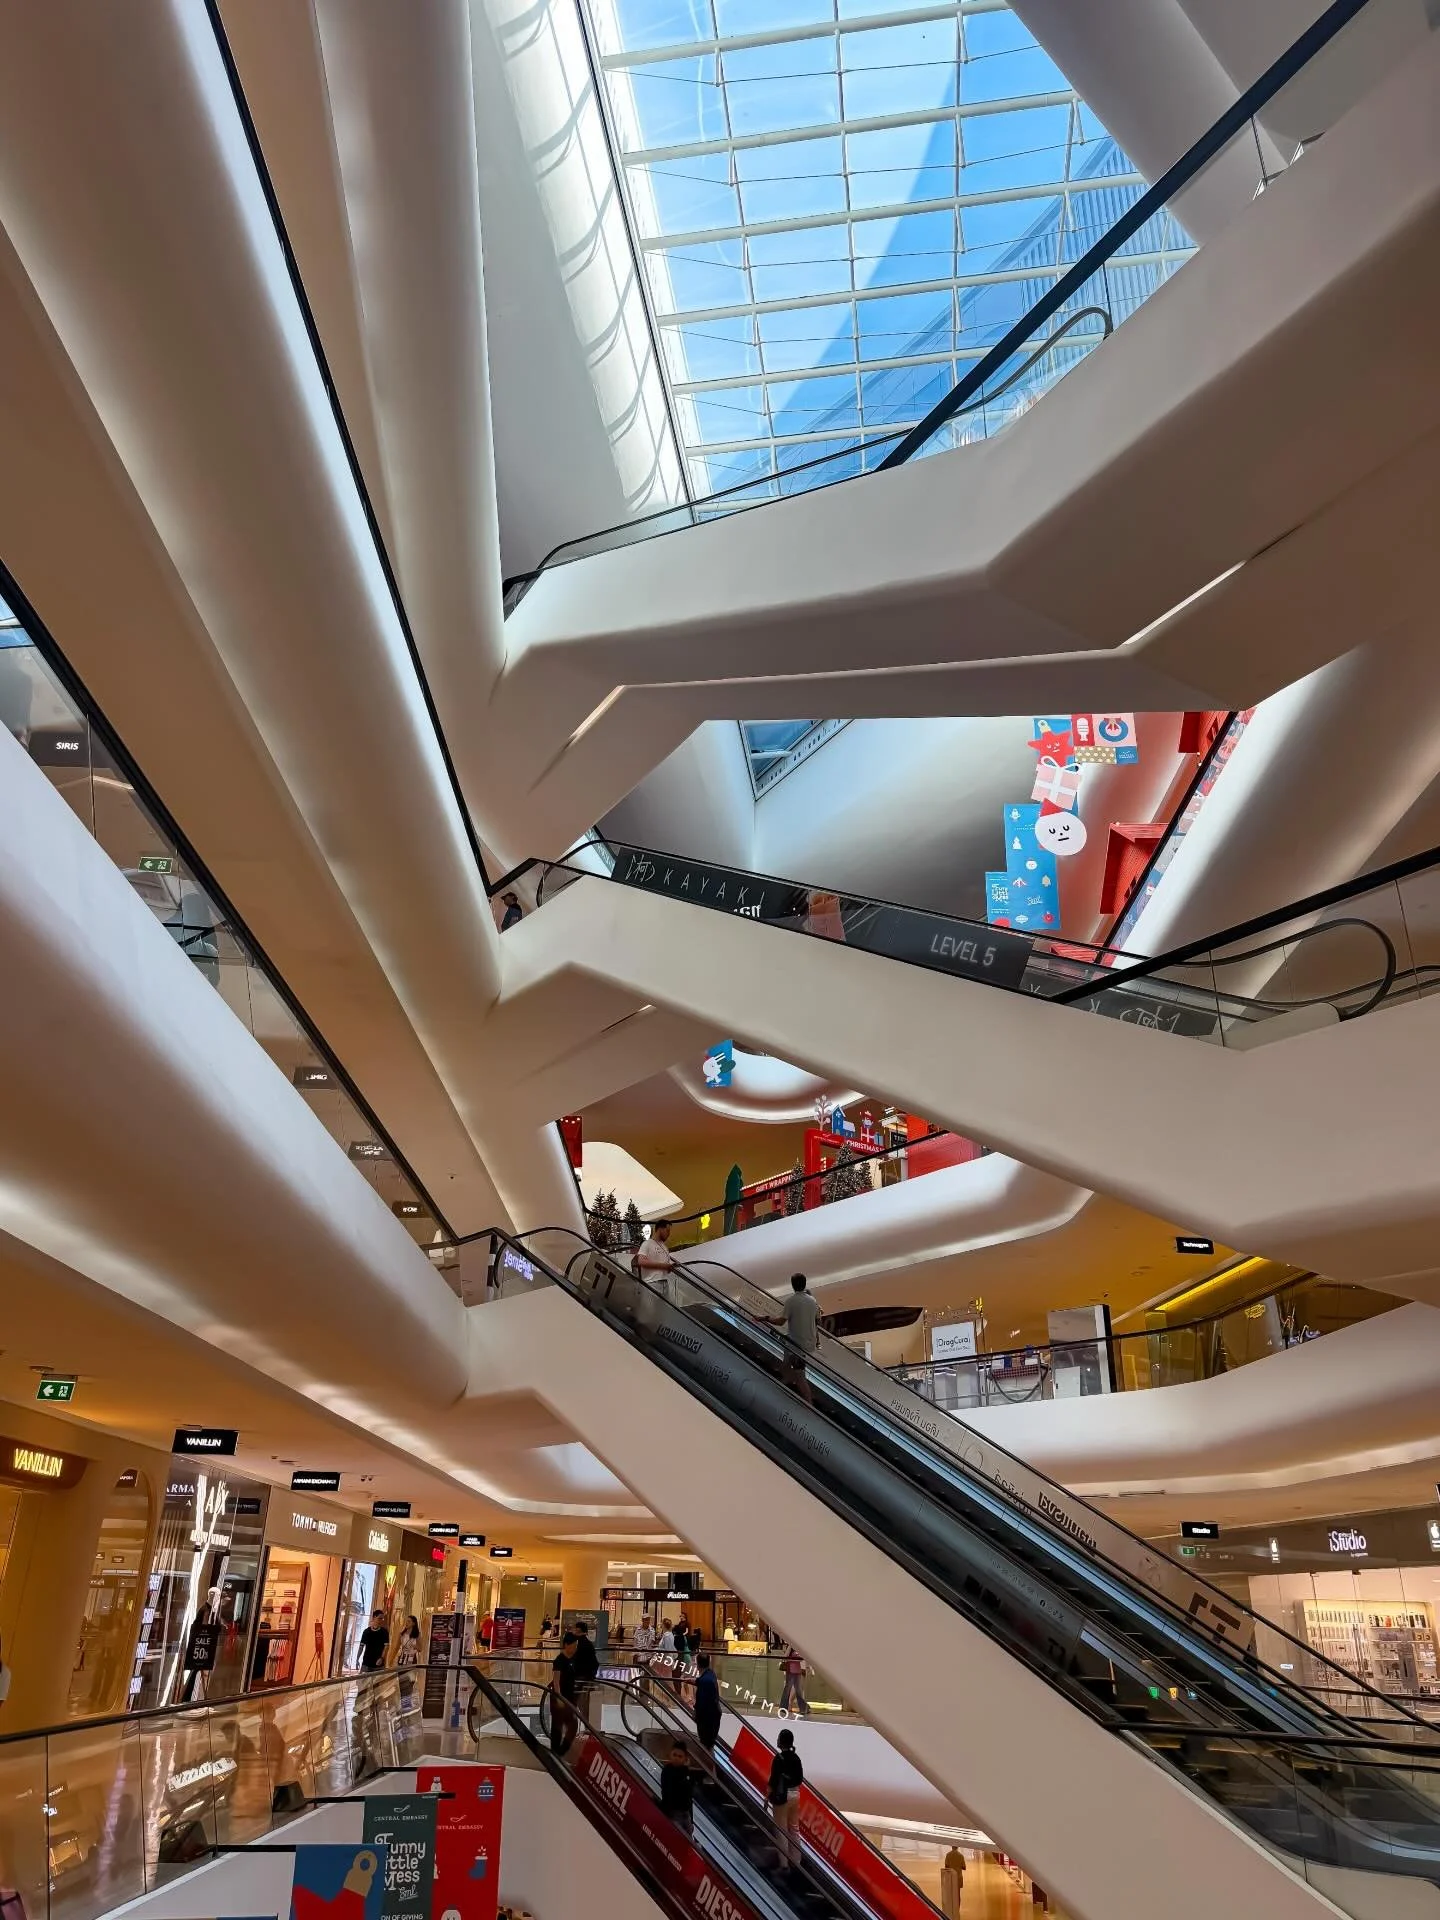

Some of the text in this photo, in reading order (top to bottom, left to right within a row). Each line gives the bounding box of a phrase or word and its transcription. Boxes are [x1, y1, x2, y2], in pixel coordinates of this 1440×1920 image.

[55, 741, 79, 751] SIRIS
[663, 868, 765, 906] KAYAKI
[930, 933, 997, 967] LEVEL 5
[185, 1437, 222, 1448] VANILLIN
[13, 1447, 64, 1478] VANILLIN
[291, 1512, 313, 1531] TOMMY
[195, 1637, 212, 1645] SALE
[588, 1751, 632, 1816] DIESEL
[374, 1832, 427, 1860] Funny
